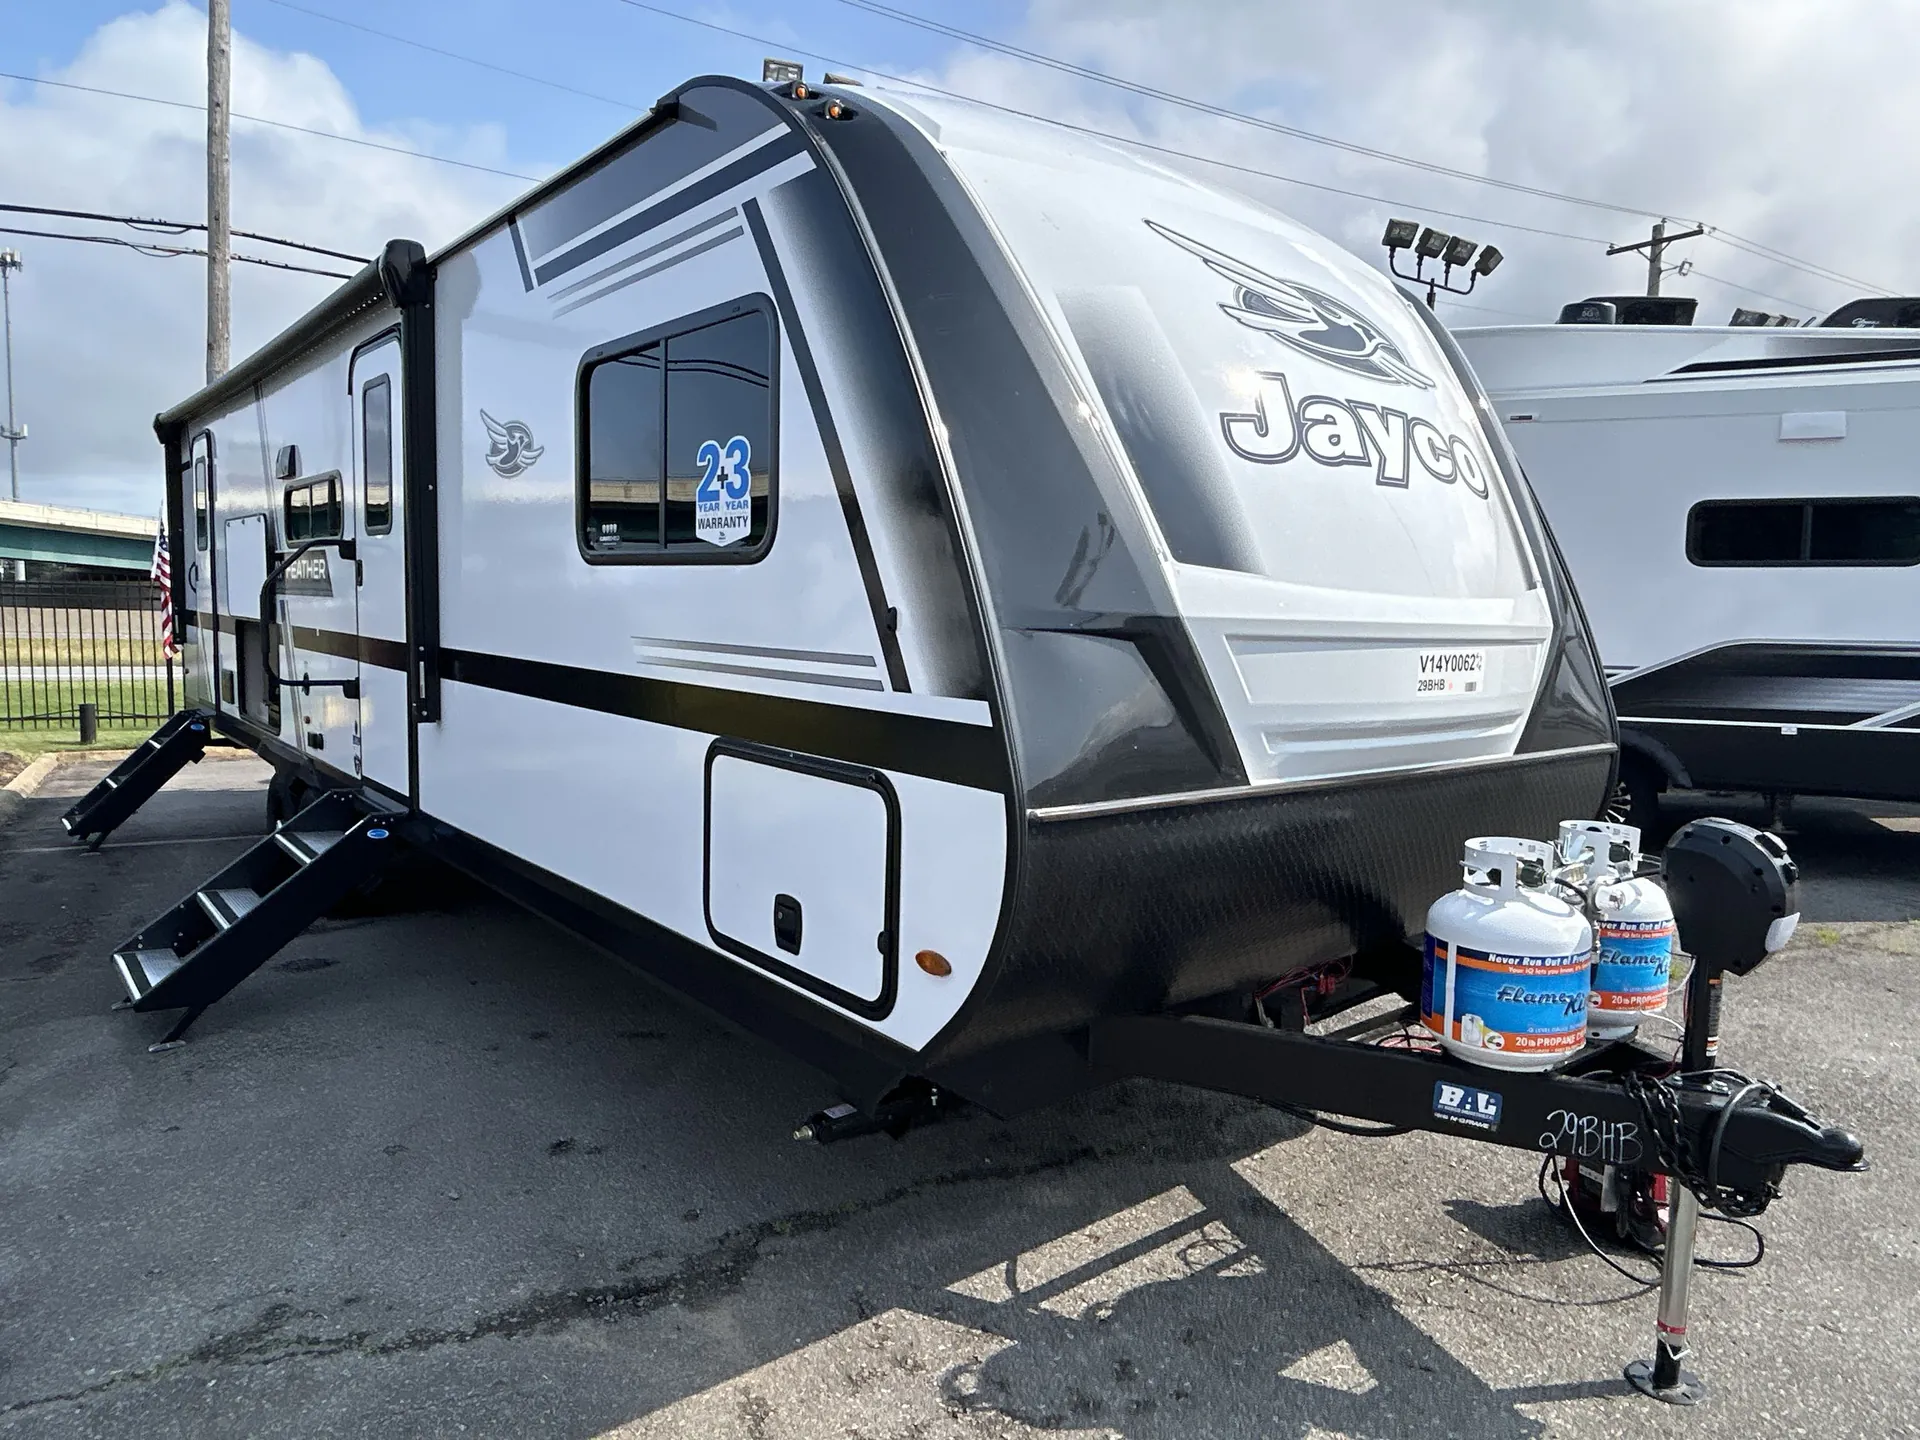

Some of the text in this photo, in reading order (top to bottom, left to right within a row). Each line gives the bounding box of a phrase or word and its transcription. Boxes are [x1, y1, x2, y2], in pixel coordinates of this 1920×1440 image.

[1220, 371, 1488, 499] Jayco
[698, 500, 749, 512] YEAR YEAR
[698, 515, 749, 530] WARRANTY
[1417, 678, 1446, 692] 29BHB
[1620, 922, 1637, 931] Run
[1488, 953, 1520, 965] Never
[1522, 957, 1542, 966] Run
[1545, 957, 1561, 966] Out
[1600, 949, 1660, 966] Flame
[1496, 984, 1566, 1004] Flame
[1536, 1034, 1576, 1047] PROPANE
[1539, 1109, 1643, 1165] 29BHB
